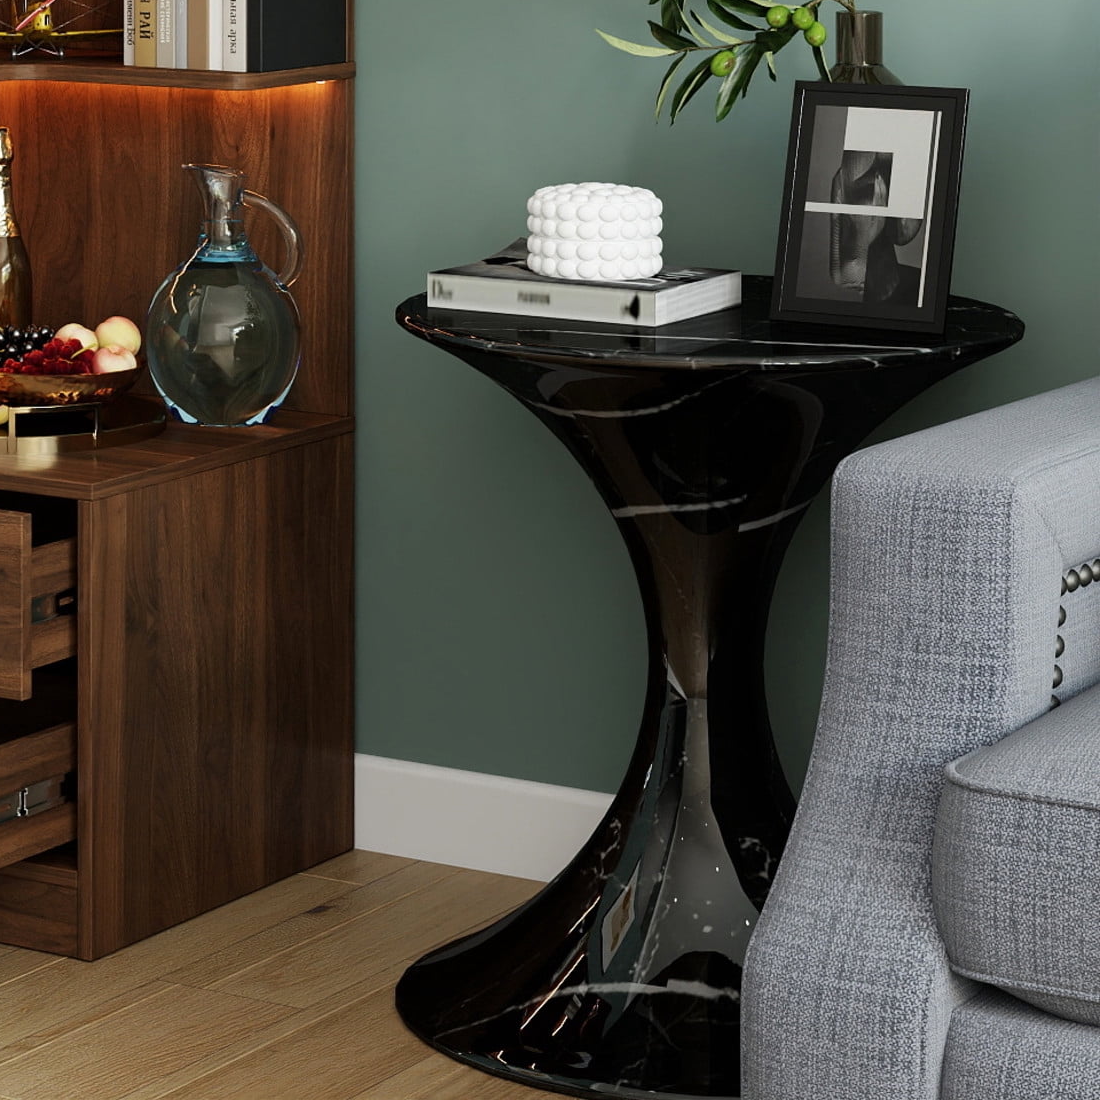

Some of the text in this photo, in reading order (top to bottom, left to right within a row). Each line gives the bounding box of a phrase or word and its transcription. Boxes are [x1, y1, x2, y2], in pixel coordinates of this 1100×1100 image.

[127, 28, 135, 45] Боб
[140, 12, 153, 39] РАЙ
[228, 29, 238, 54] арка
